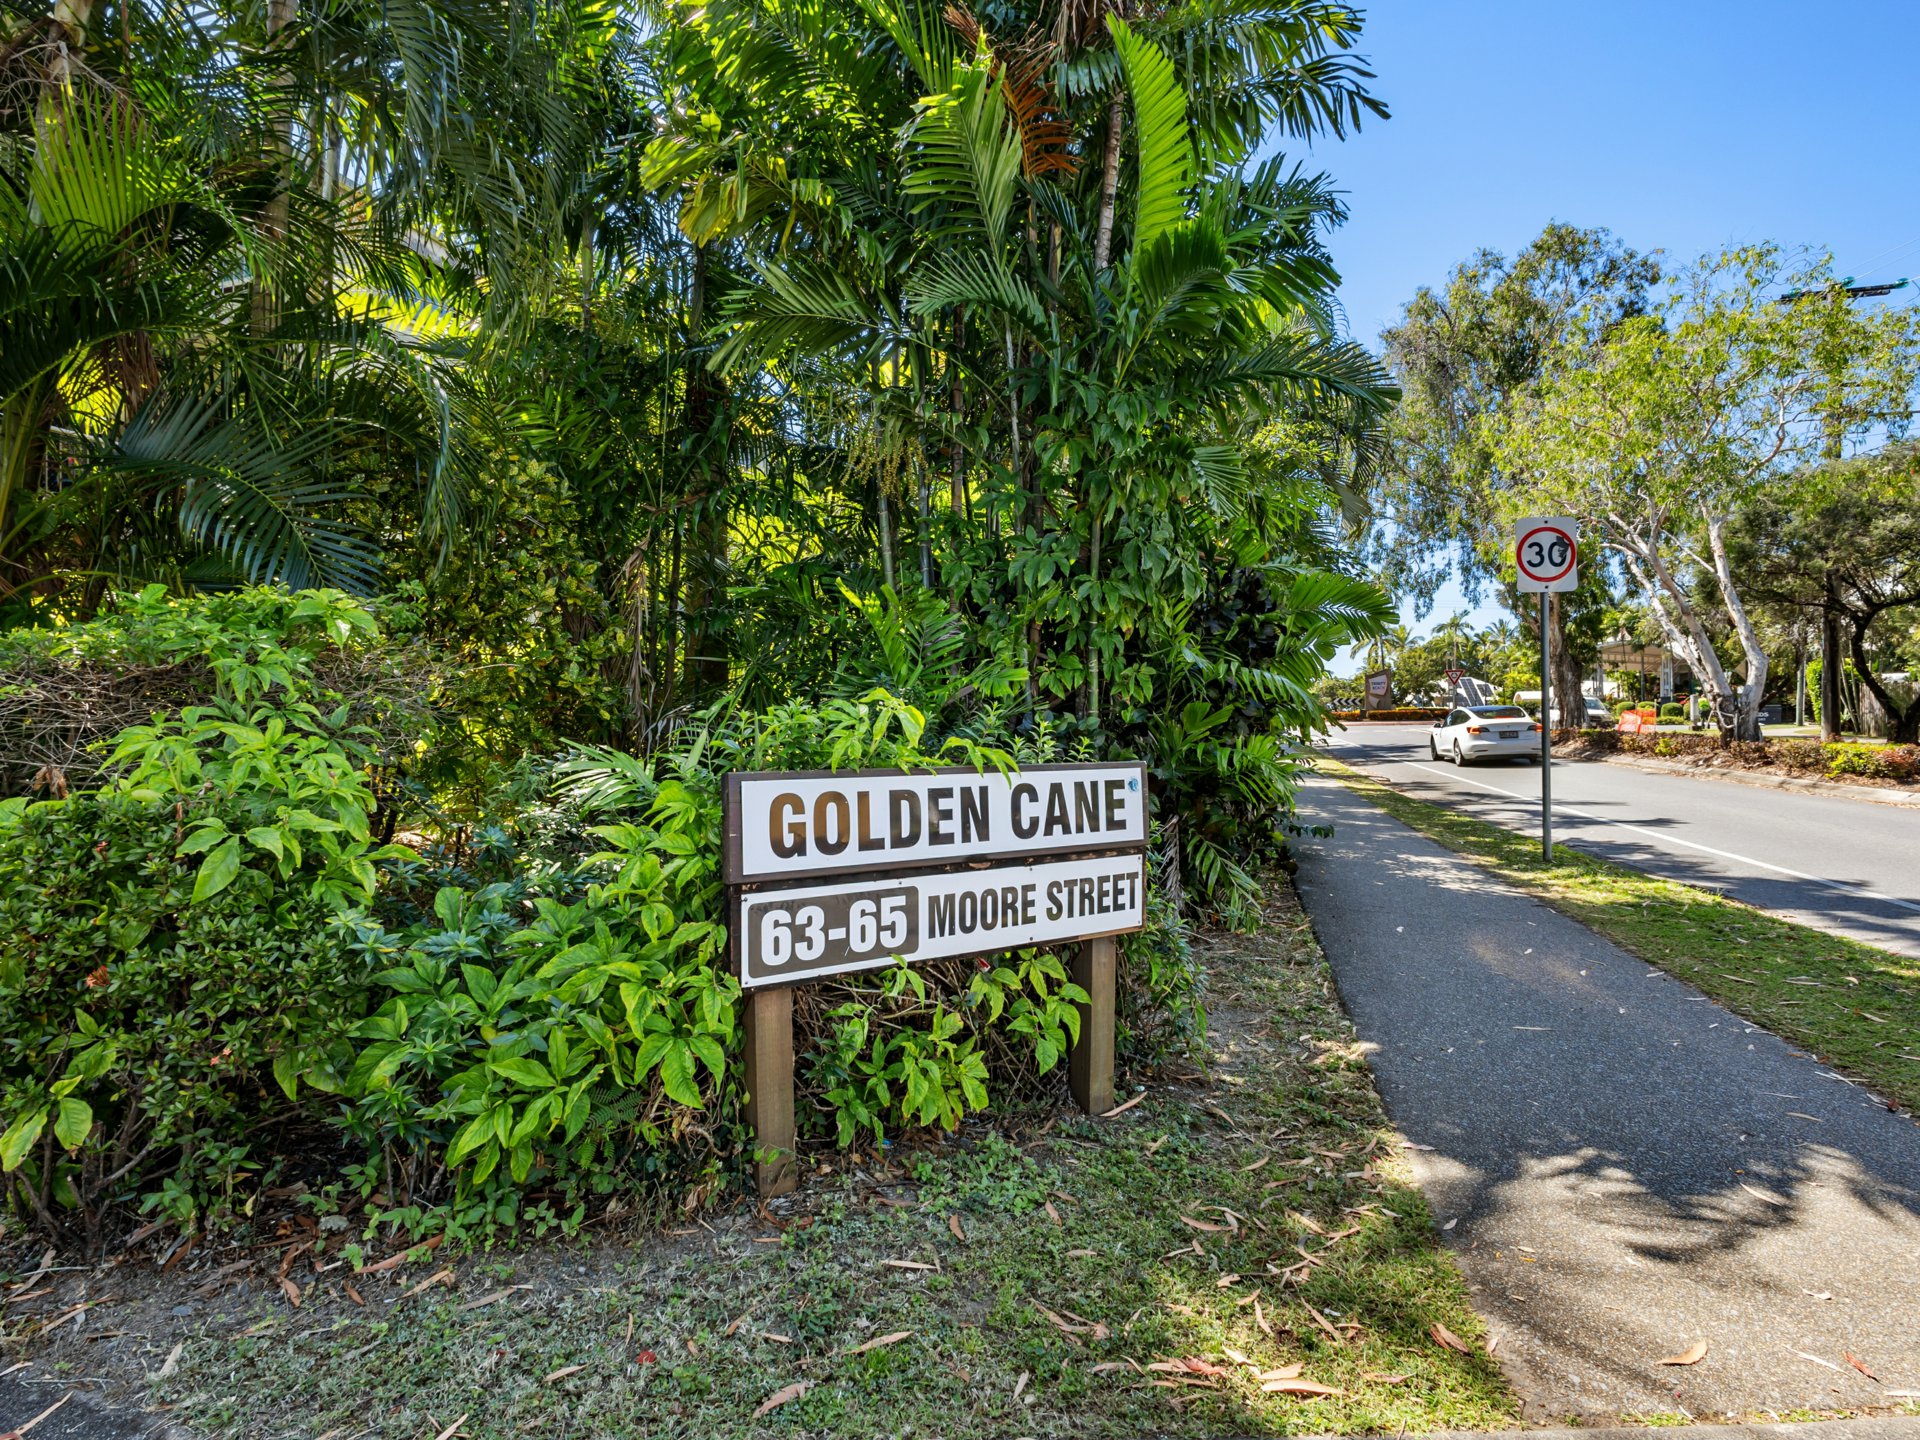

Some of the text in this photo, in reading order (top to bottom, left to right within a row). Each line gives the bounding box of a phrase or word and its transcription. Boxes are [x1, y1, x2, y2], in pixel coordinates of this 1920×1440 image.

[1526, 541, 1567, 568] 30
[768, 779, 1127, 859] GOLDEN CANE
[760, 871, 1139, 966] 63-65 MOORE STREET
